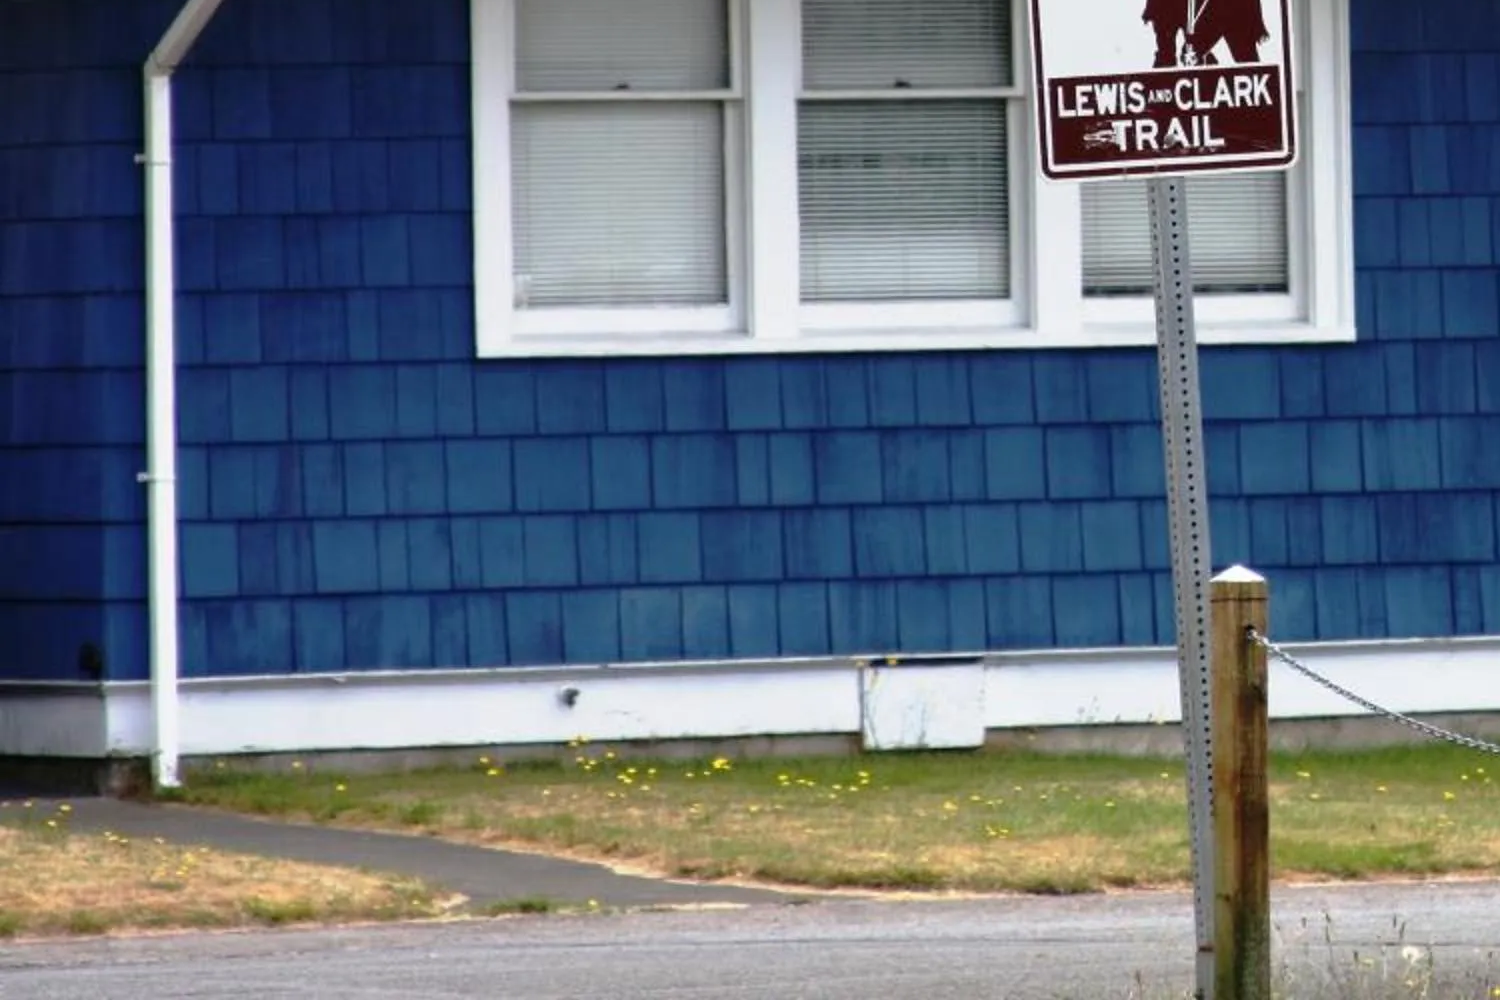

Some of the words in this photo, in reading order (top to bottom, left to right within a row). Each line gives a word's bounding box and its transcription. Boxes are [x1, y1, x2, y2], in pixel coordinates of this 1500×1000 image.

[1057, 81, 1147, 117] LEWIS
[1148, 88, 1173, 104] AND
[1174, 73, 1273, 111] CLARK
[1111, 115, 1225, 152] TRAIL
